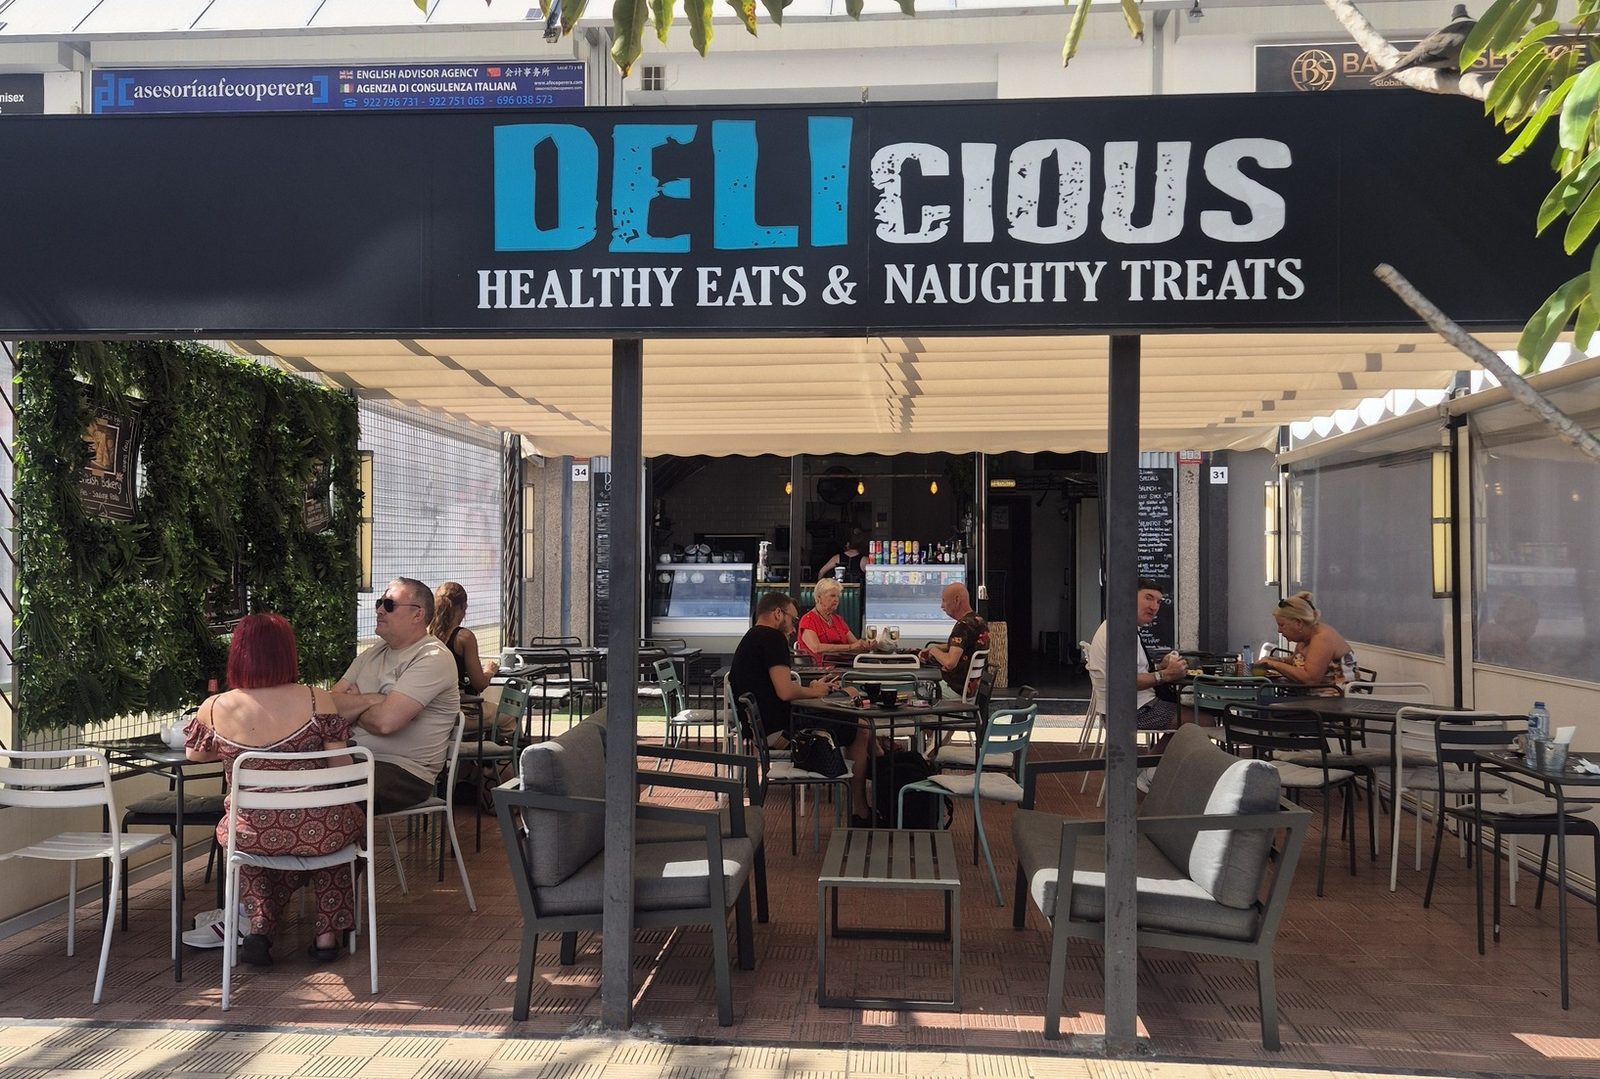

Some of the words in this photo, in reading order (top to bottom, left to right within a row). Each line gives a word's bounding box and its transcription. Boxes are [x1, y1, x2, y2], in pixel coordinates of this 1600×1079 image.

[356, 70, 396, 79] ENGLISH
[398, 69, 439, 79] ADVISOR
[441, 68, 479, 78] AGENCY
[504, 67, 551, 78] 会计事务所
[133, 78, 314, 101] asesoríaafecoperera
[356, 84, 397, 93] AGENZIA
[399, 84, 409, 93] DI
[411, 82, 473, 92] CONSULENZA
[474, 82, 517, 91] ITALIANA
[363, 98, 383, 107] 922
[383, 98, 401, 107] 796
[402, 98, 419, 107] 731
[429, 97, 446, 106] 922
[448, 97, 465, 106] 751
[467, 96, 485, 105] 063
[497, 95, 514, 105] 696
[516, 95, 534, 104] 038
[536, 95, 553, 104] 573
[494, 116, 1292, 253] DELICIOUS
[477, 267, 683, 309] HEALTHY
[696, 264, 807, 308] EATS
[821, 264, 857, 306] &
[884, 260, 1107, 304] NAUGHTY
[1121, 258, 1306, 301] TREATS
[574, 468, 587, 476] 34
[1212, 471, 1225, 479] 31
